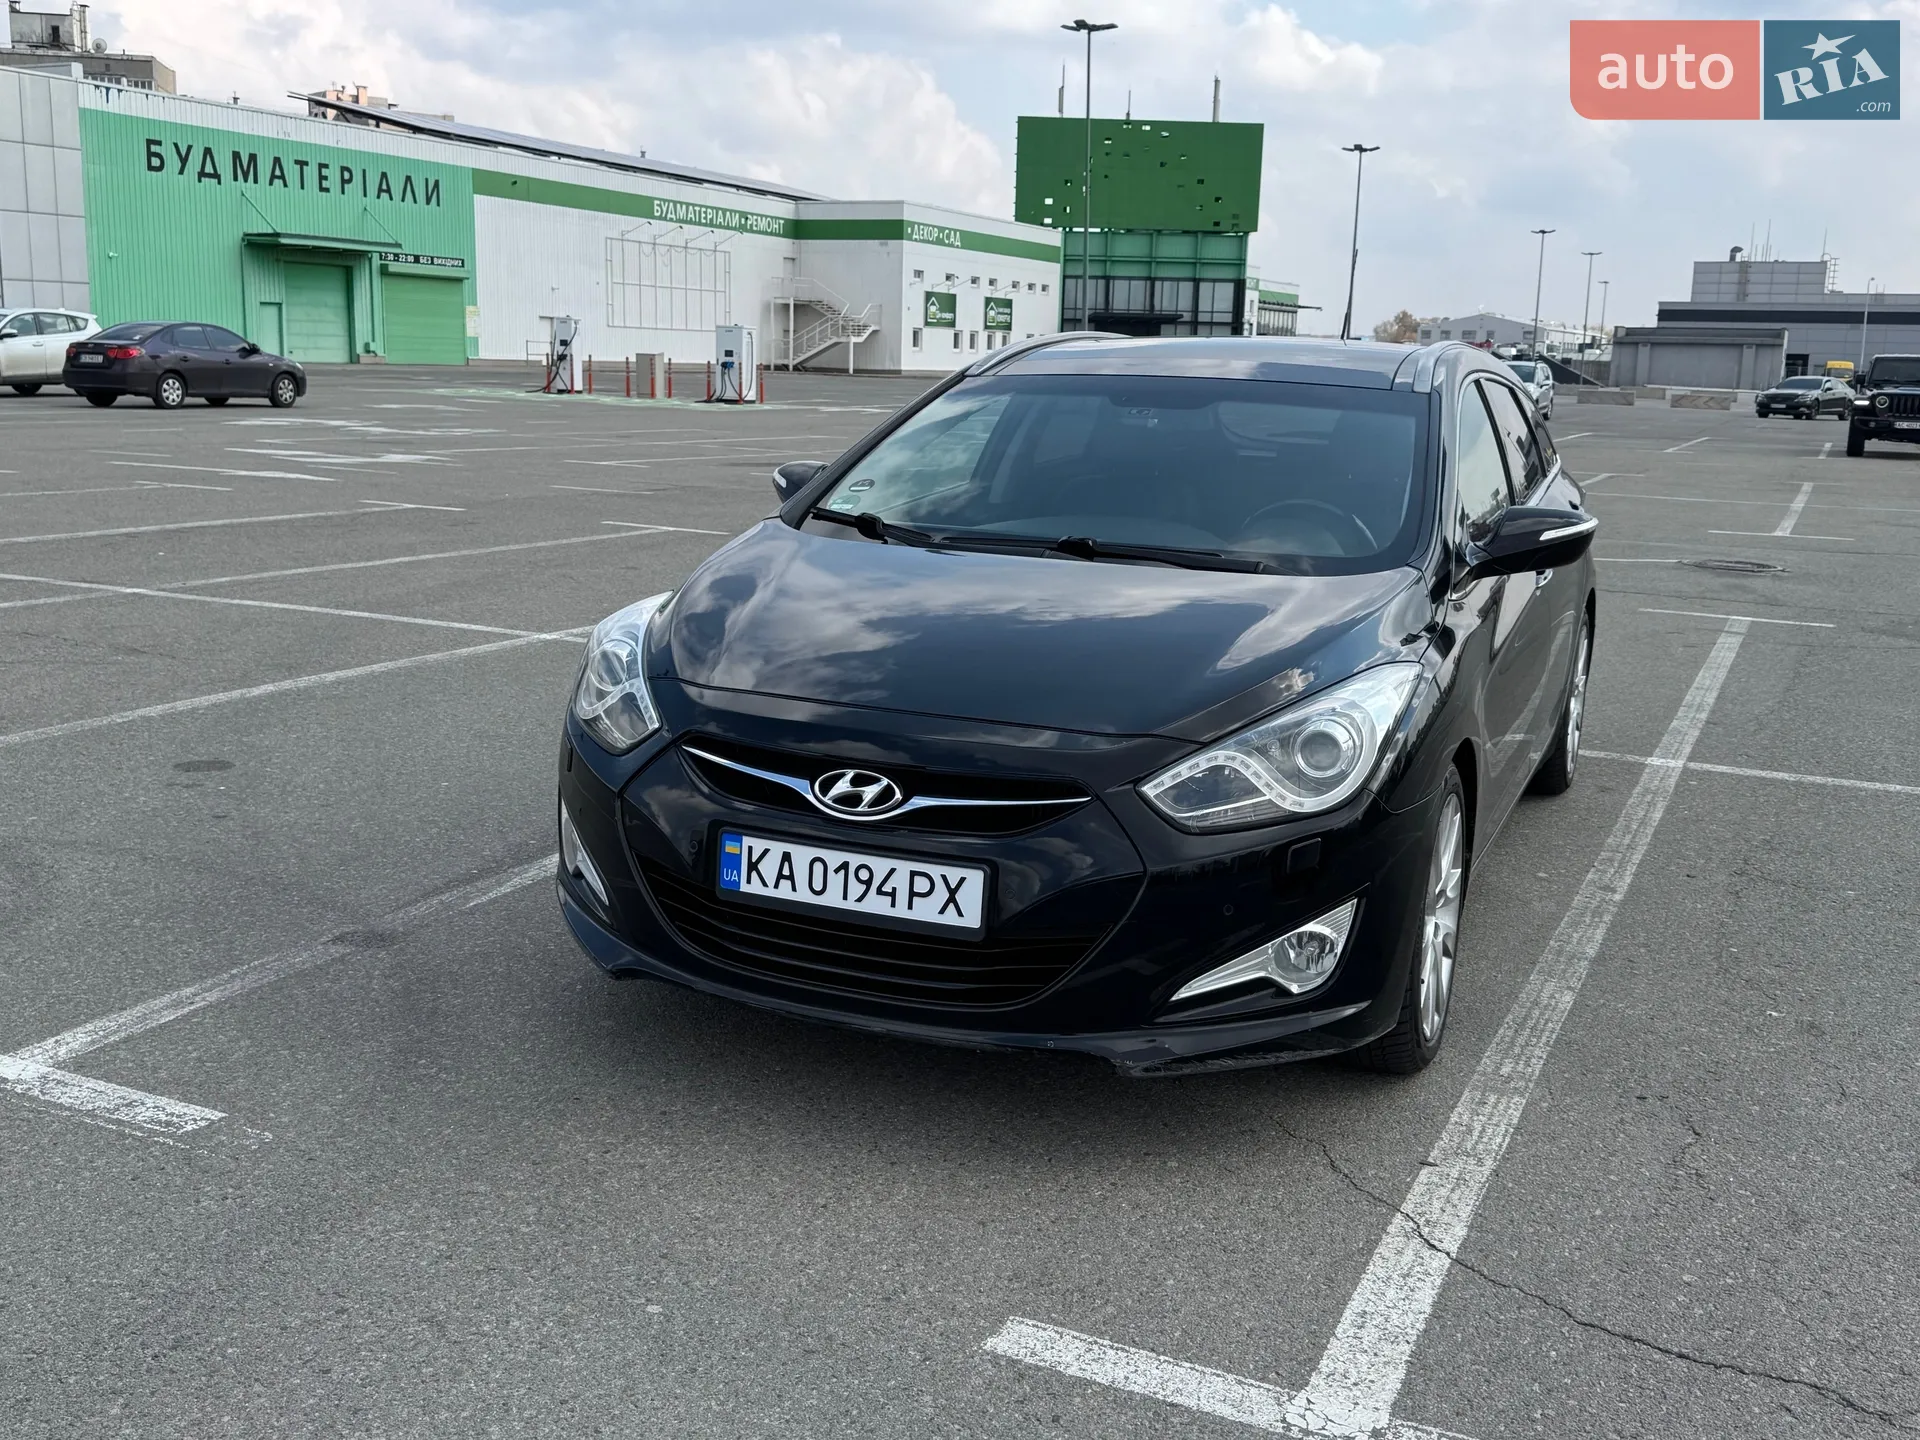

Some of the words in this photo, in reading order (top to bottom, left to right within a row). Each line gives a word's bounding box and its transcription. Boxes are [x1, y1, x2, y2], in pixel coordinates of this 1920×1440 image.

[145, 138, 441, 207] БУДМАТЕРІАЛИ
[653, 200, 740, 229] БУДМАТЕРІАЛИ
[746, 214, 785, 235] РЕМОНТ
[912, 224, 939, 242] ДЕКОР
[943, 229, 962, 248] САД
[381, 252, 394, 261] 7:30
[419, 256, 432, 265] БЕЗ
[723, 868, 739, 883] UA
[746, 845, 967, 918] KA0194PX
